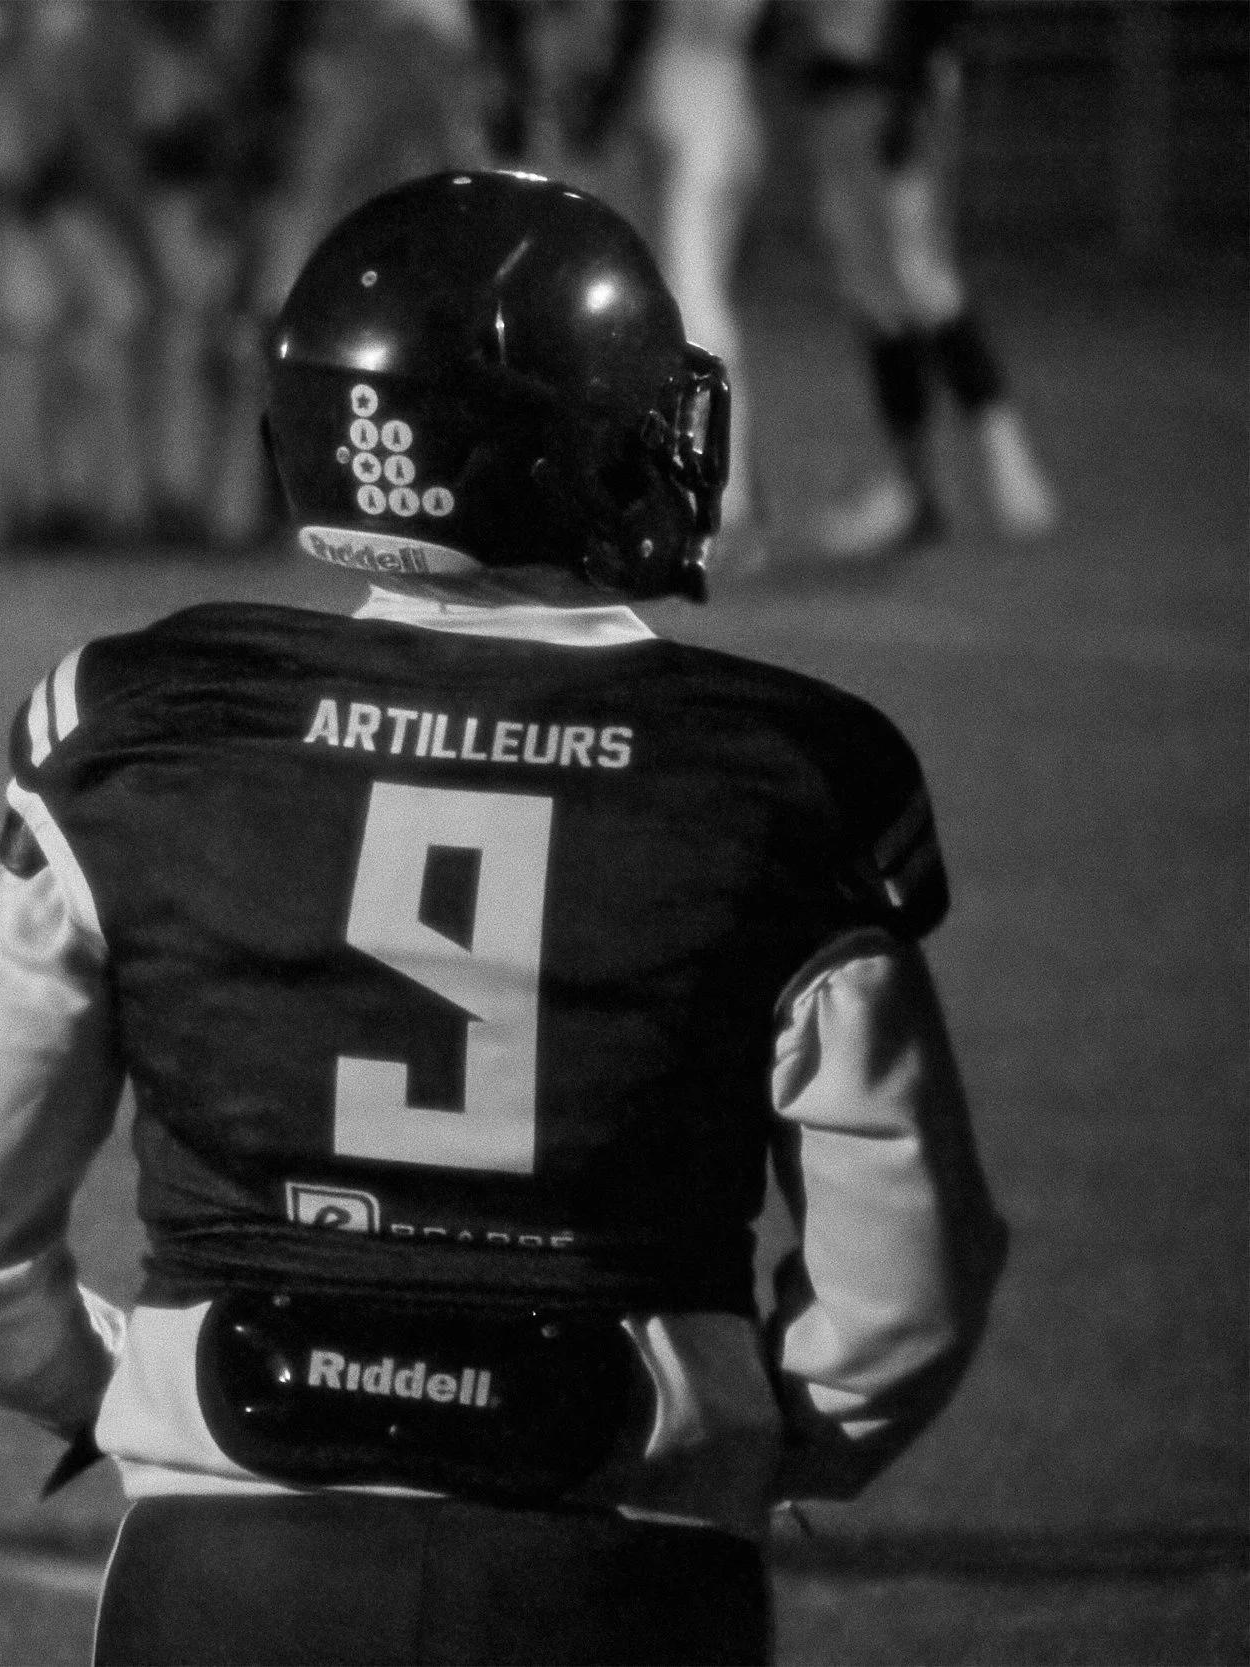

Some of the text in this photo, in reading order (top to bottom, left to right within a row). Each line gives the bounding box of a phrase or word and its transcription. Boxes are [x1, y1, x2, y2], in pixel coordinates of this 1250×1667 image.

[303, 699, 634, 769] ARTILLEURS
[333, 781, 554, 1174] 9
[308, 1350, 492, 1407] Riddell
